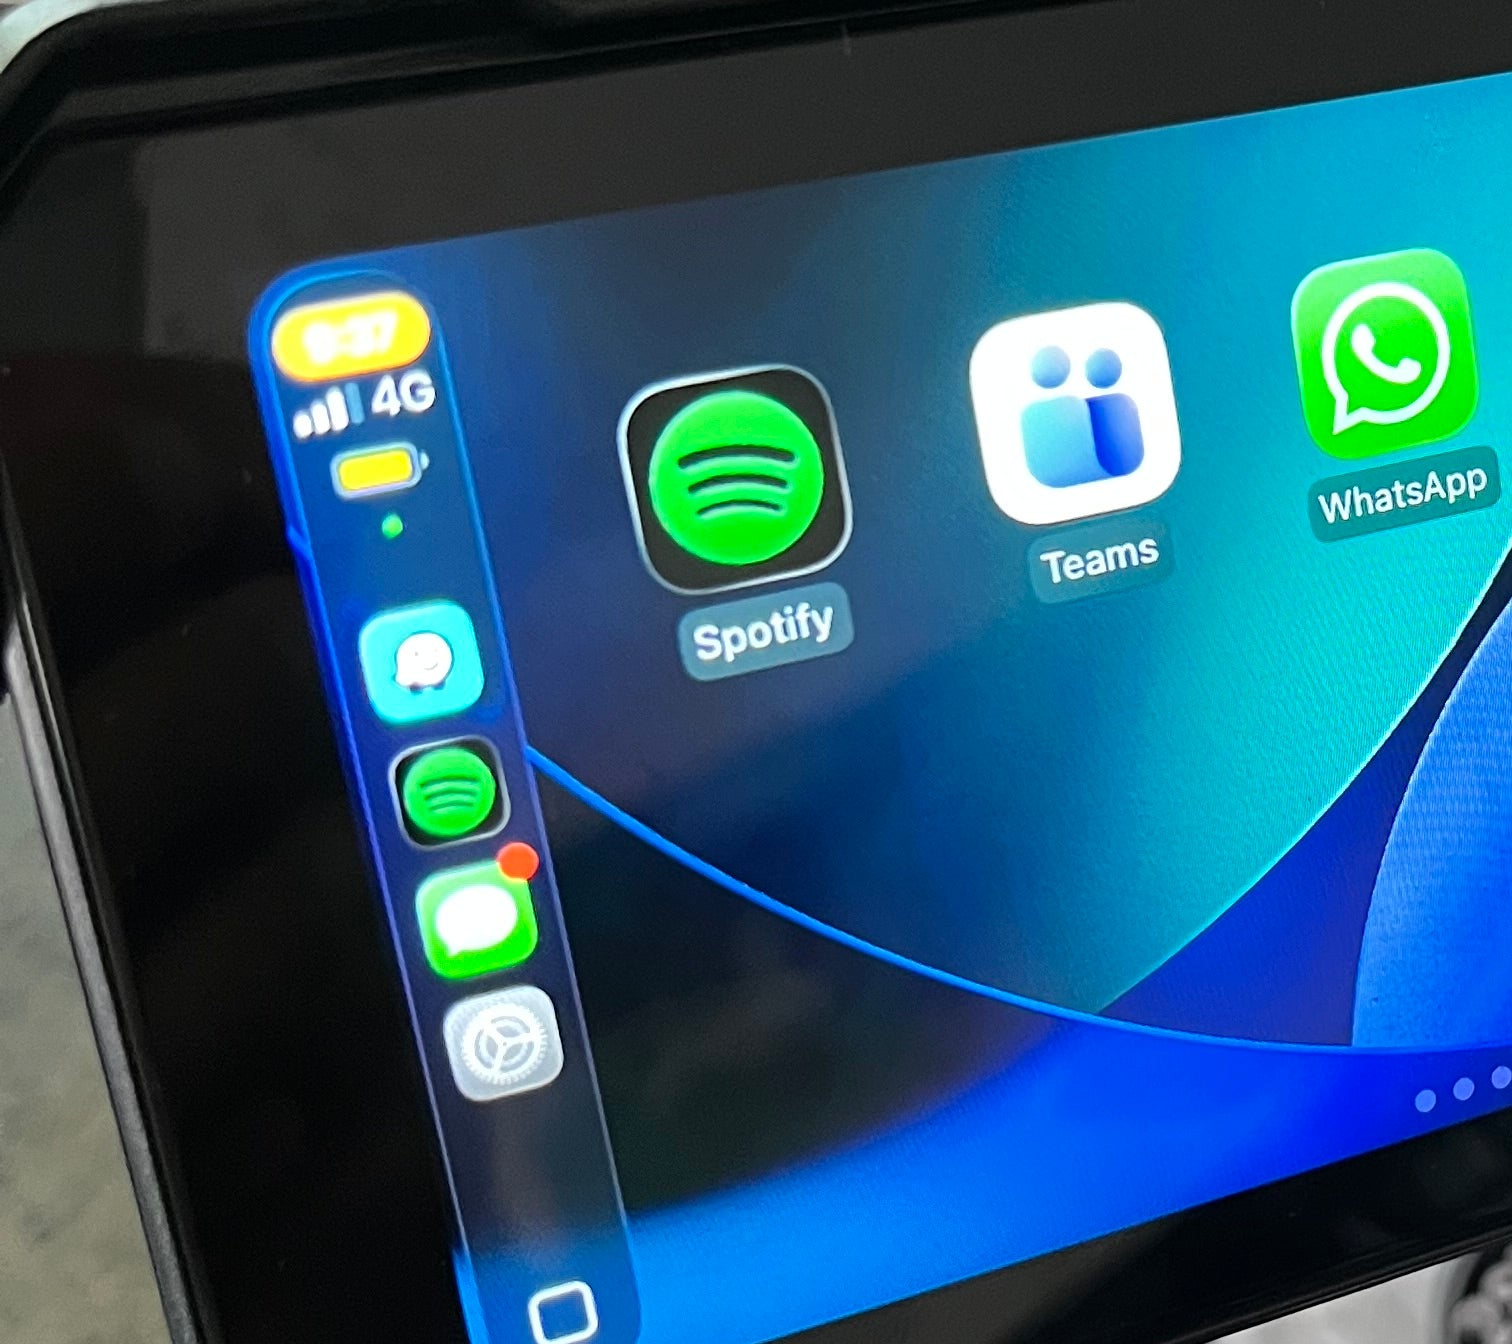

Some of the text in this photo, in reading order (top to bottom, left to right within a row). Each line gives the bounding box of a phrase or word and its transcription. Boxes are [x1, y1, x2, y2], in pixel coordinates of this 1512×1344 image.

[371, 369, 436, 416] 4G
[1317, 464, 1488, 524] WhatsApp
[1039, 537, 1160, 585] Teams
[692, 601, 834, 663] Spotify
